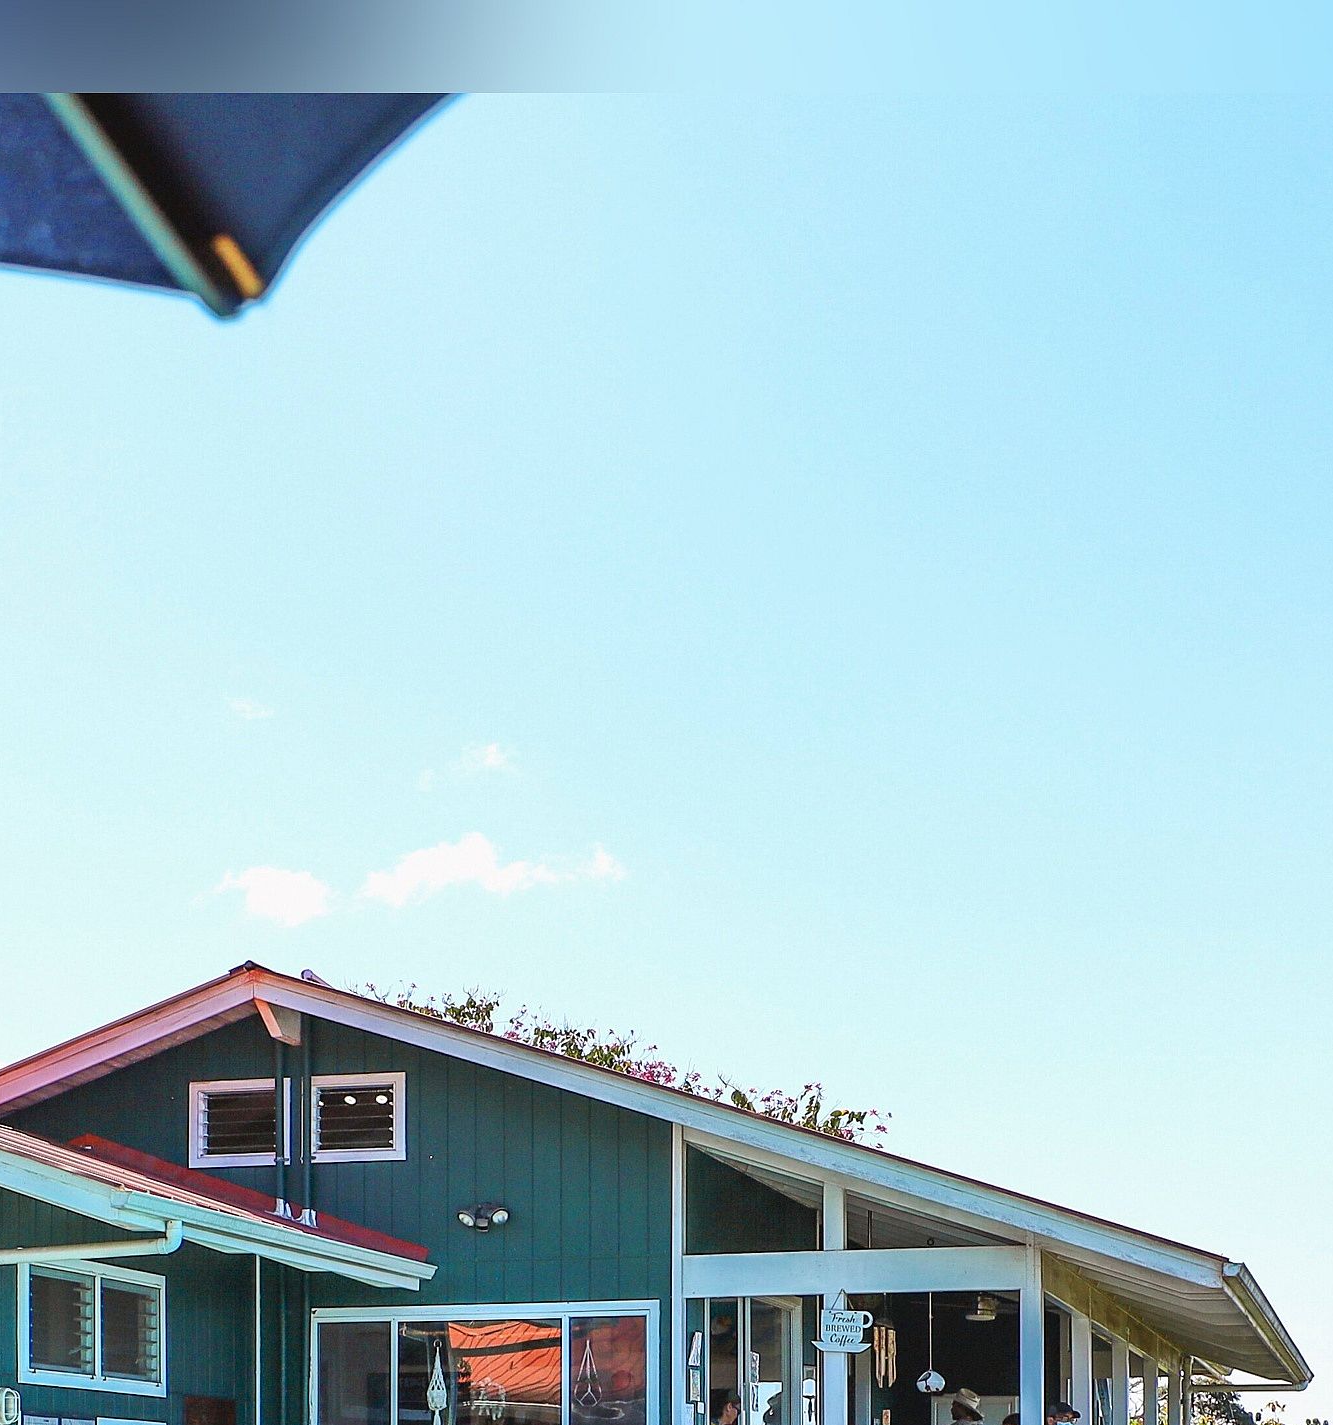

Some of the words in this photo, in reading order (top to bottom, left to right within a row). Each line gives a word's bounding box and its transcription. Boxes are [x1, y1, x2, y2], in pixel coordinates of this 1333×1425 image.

[831, 1312, 855, 1323] Fresh
[826, 1324, 861, 1333] BREWED
[830, 1333, 855, 1346] Coffee
